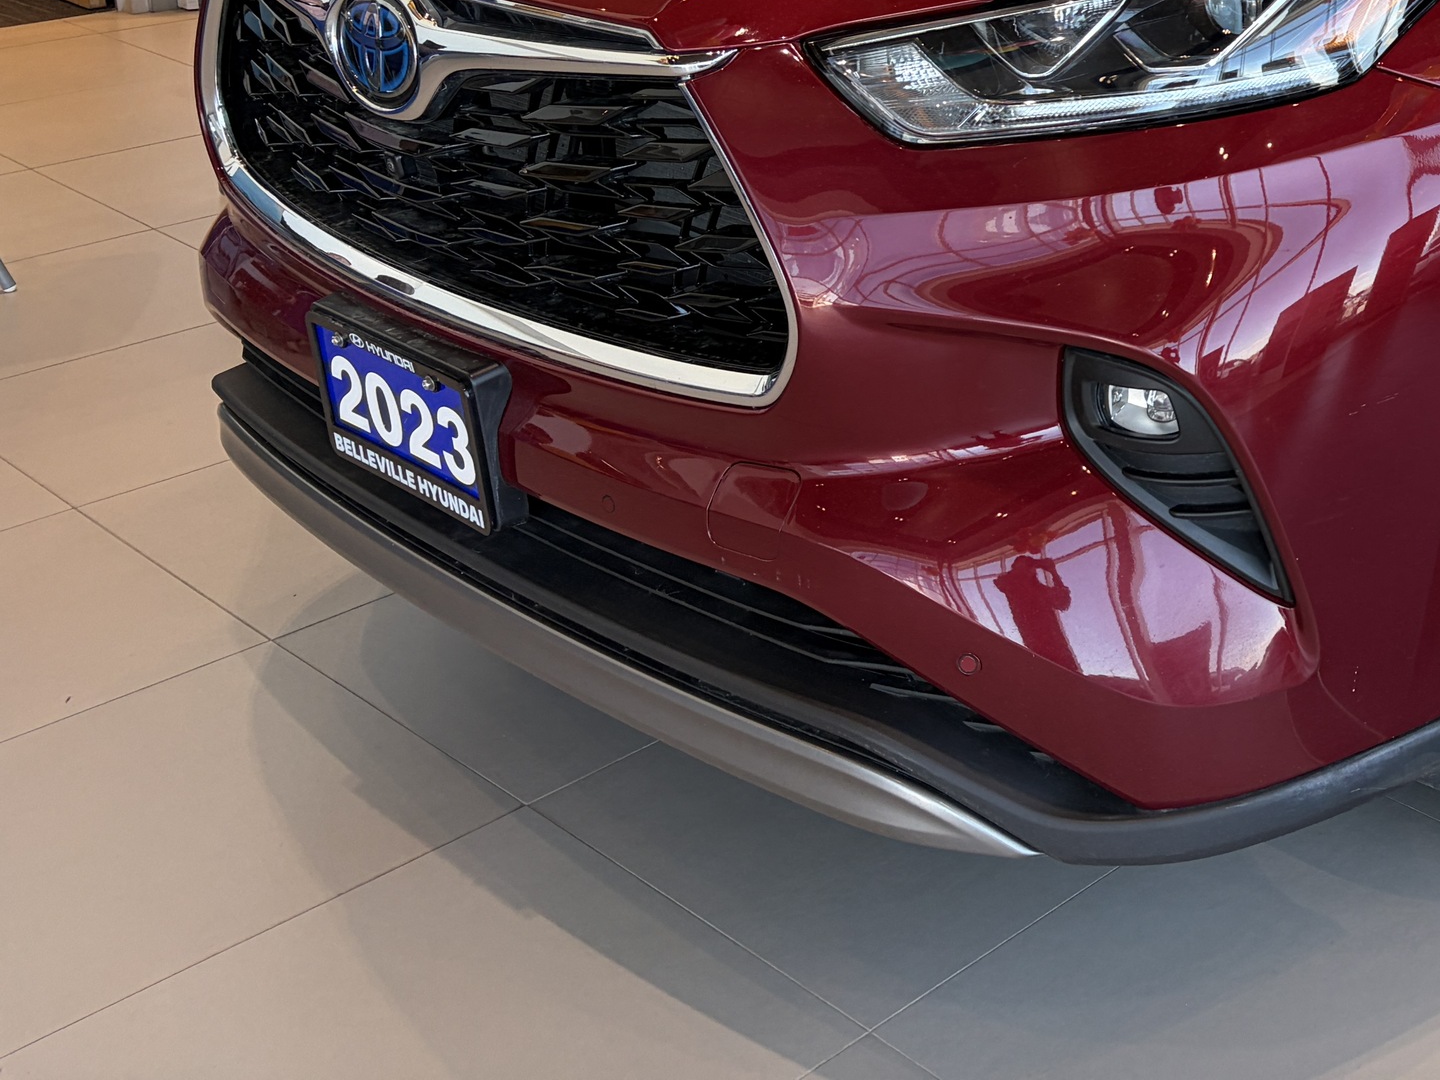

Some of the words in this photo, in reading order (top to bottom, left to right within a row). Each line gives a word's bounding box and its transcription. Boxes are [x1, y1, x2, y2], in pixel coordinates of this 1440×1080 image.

[366, 341, 415, 373] HYUNDAI
[331, 356, 476, 486] 2023
[334, 432, 417, 489] BELLEVILLE
[418, 475, 485, 529] HYUNDAI
